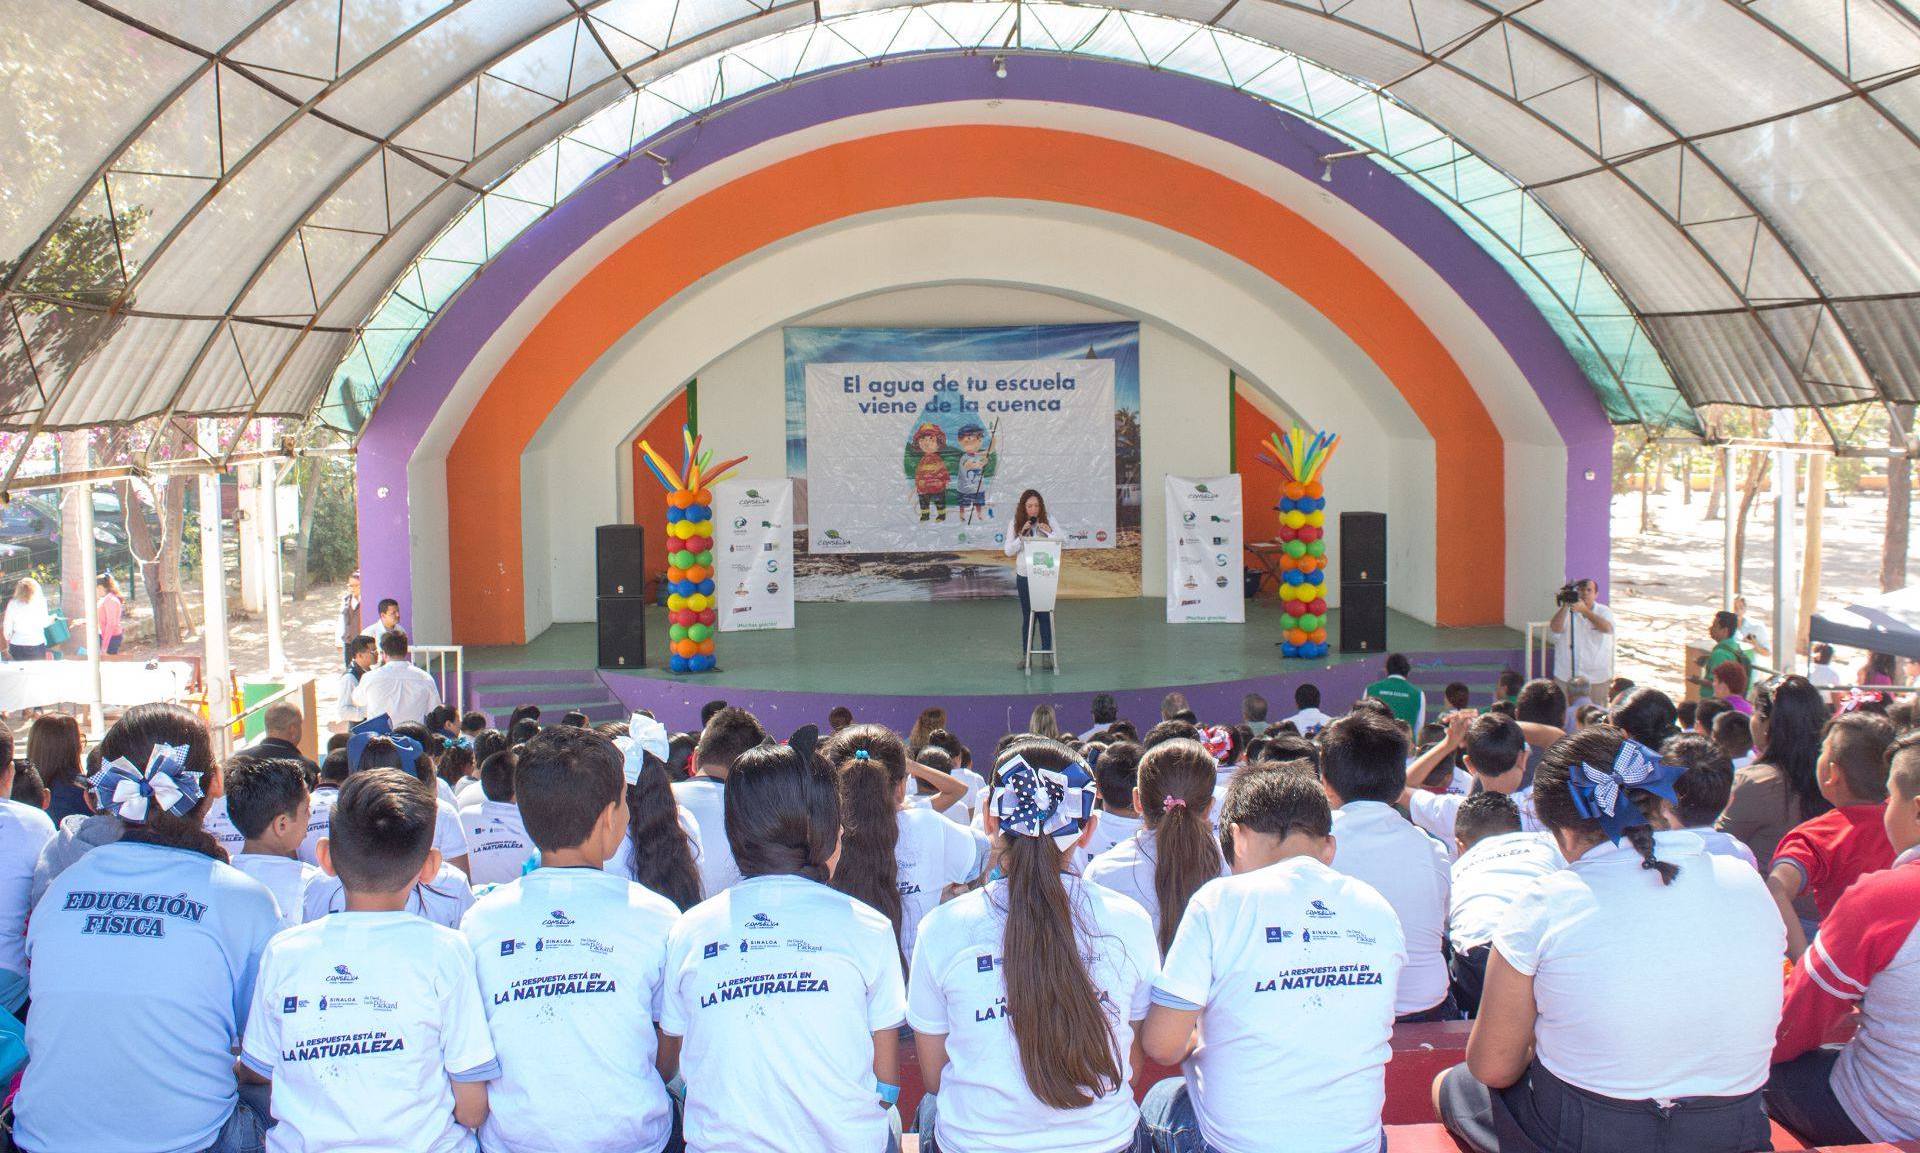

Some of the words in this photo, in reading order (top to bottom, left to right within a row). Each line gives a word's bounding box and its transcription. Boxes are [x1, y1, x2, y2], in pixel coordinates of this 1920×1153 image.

[843, 374, 861, 393] El
[868, 378, 925, 398] agua
[932, 373, 960, 392] de
[966, 375, 988, 392] tu
[995, 371, 1076, 392] escuela
[858, 396, 918, 414] viene
[924, 394, 951, 413] de
[959, 394, 979, 412] la
[986, 397, 1061, 412] cuenca
[483, 843, 523, 851] NATURALEZA
[62, 891, 208, 922] EDUCACIÓN
[82, 910, 166, 938] FÍSICA
[1291, 966, 1337, 976] RESPUESTA
[1339, 964, 1358, 972] ESTÁ
[522, 975, 566, 986] RESPUESTA
[717, 981, 727, 989] LA
[728, 974, 775, 986] RESPUESTA
[777, 971, 798, 979] ESTÁ
[1254, 980, 1276, 992] LA
[1281, 973, 1382, 990] NATURALEZA
[494, 991, 510, 1005] LA
[514, 981, 616, 1000] NATURALEZA
[701, 992, 718, 1008] LA
[721, 979, 829, 1002] NATURALEZA
[976, 1007, 996, 1022] LA
[306, 1035, 351, 1046] RESPUESTA
[352, 1031, 373, 1041] ESTÁ
[282, 1049, 297, 1061] LA
[299, 1038, 404, 1060] NATURALEZA
